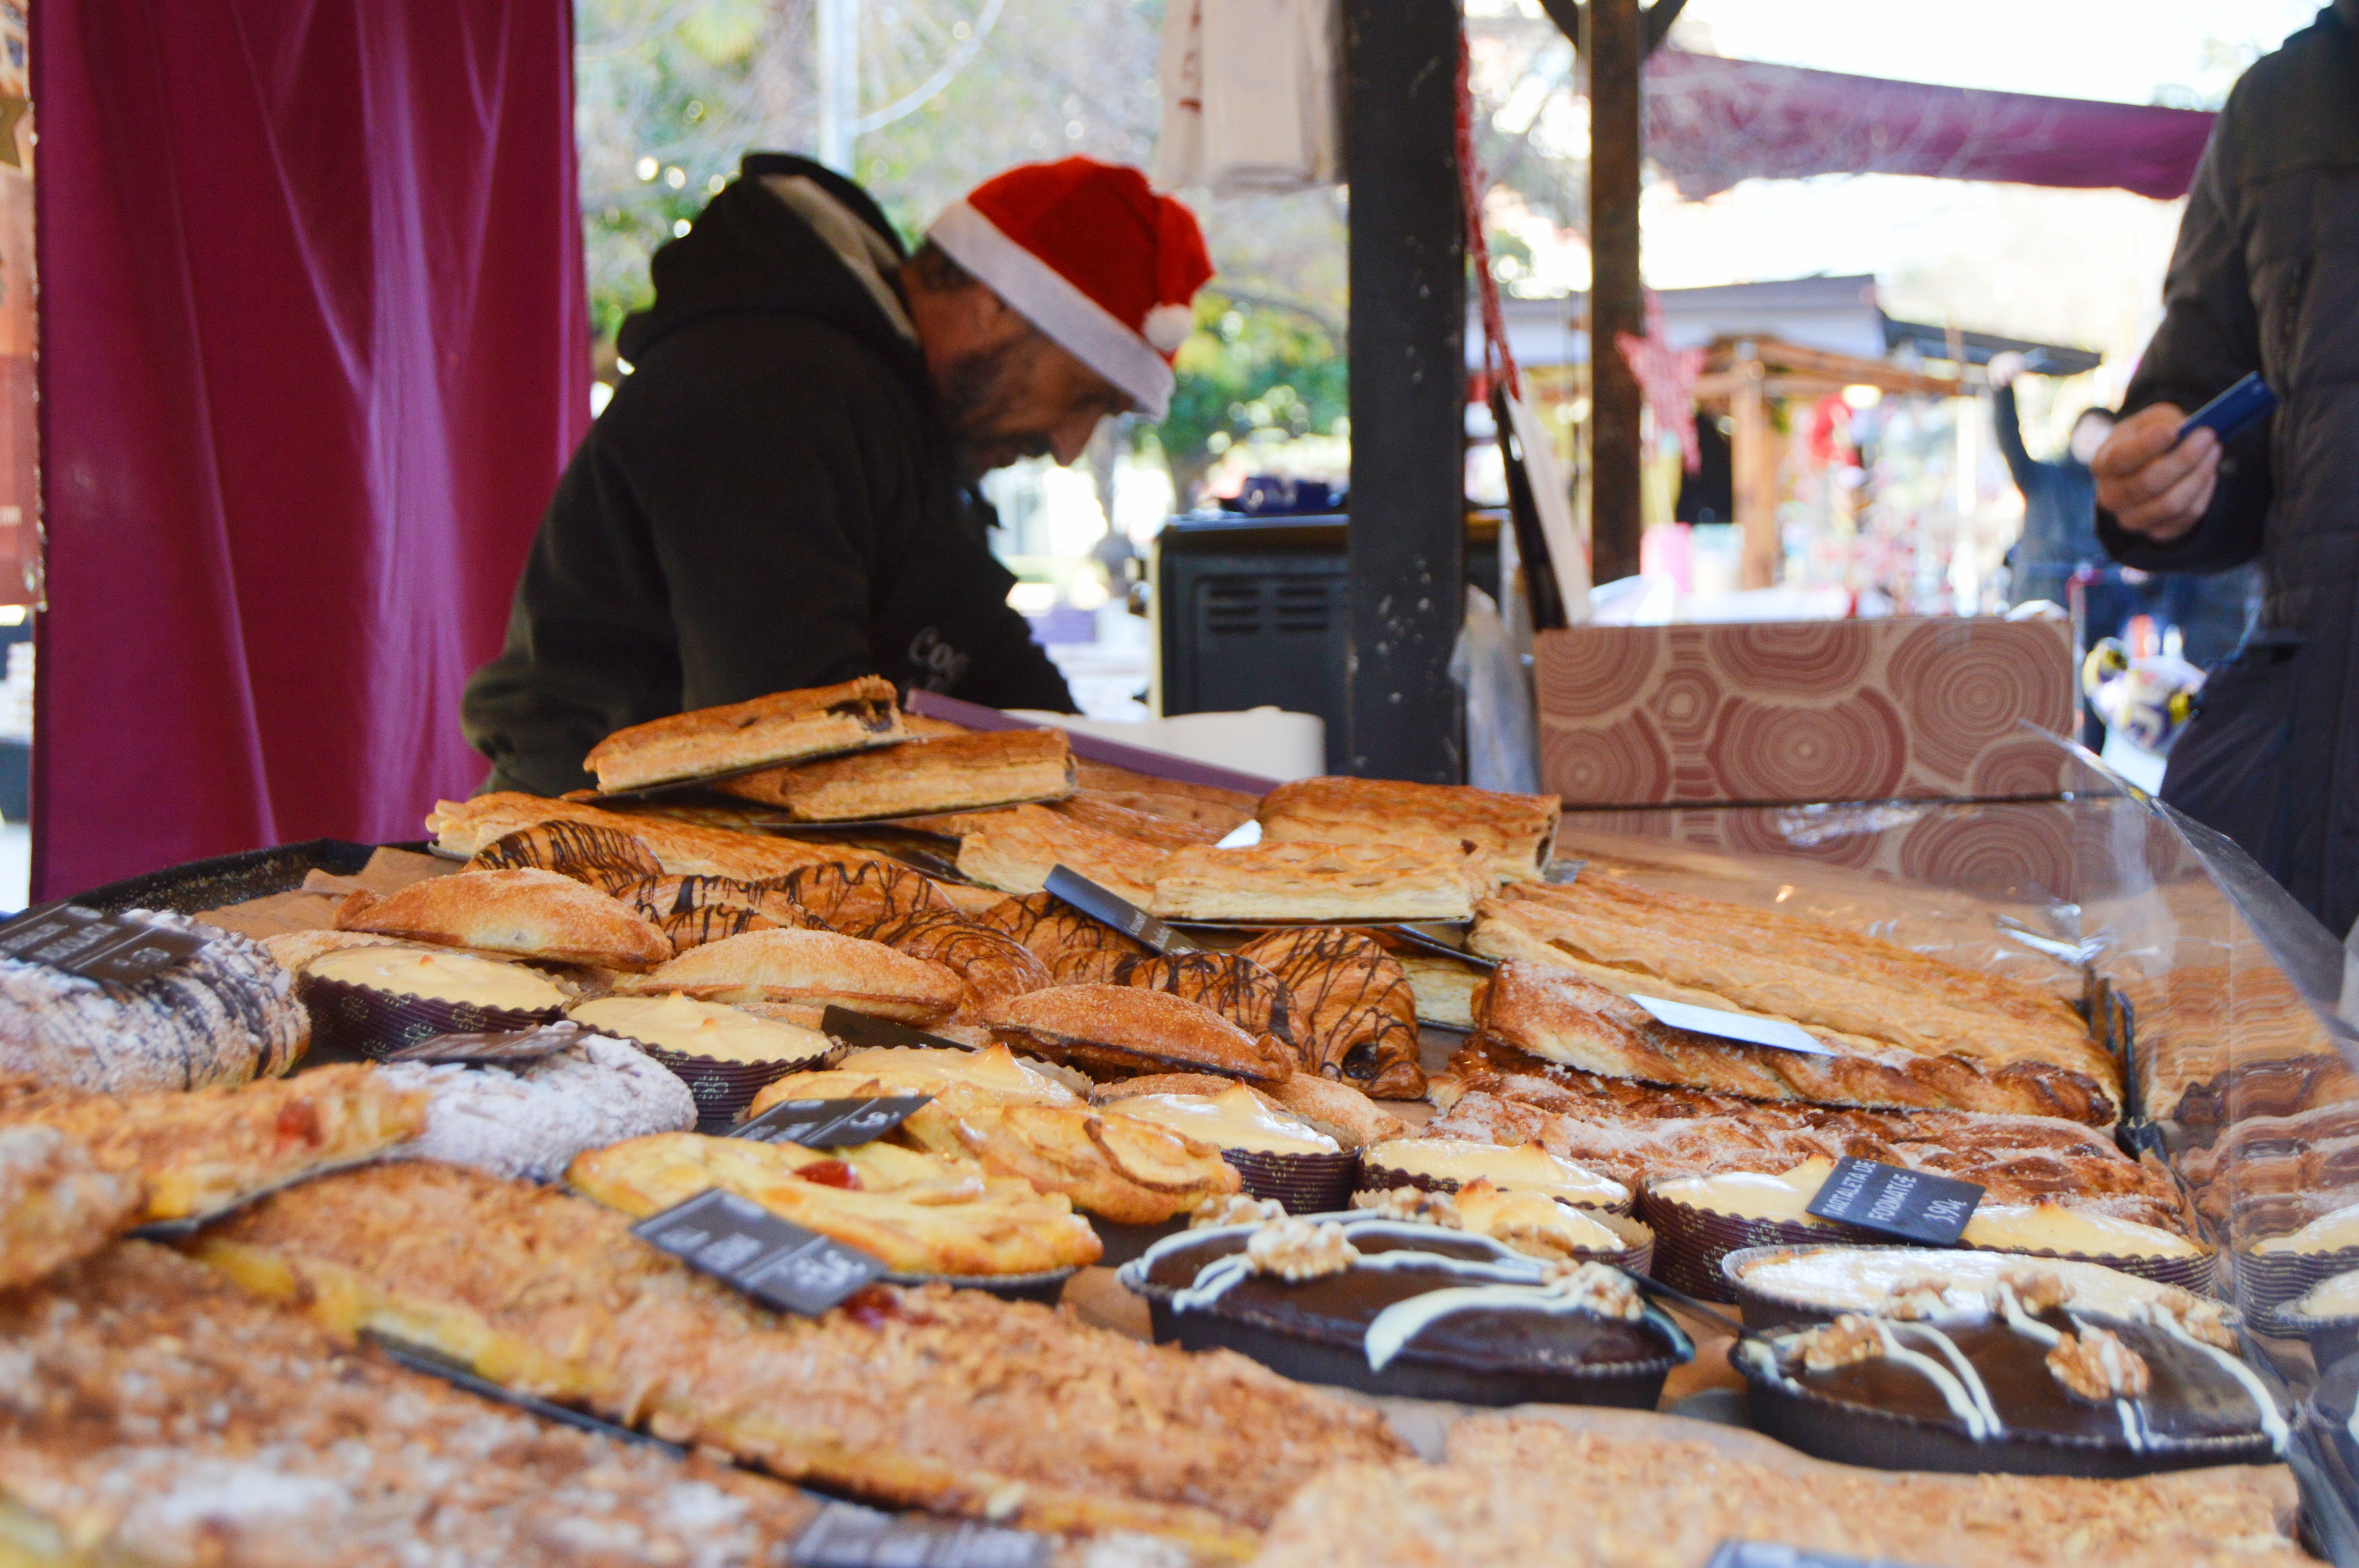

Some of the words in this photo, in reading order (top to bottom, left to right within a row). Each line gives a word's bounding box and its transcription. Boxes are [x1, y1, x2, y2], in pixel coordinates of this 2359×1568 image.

[1822, 1172, 1868, 1216] TARTALETA
[1852, 1160, 1876, 1174] DE
[1867, 1174, 1917, 1221] FORMATGE
